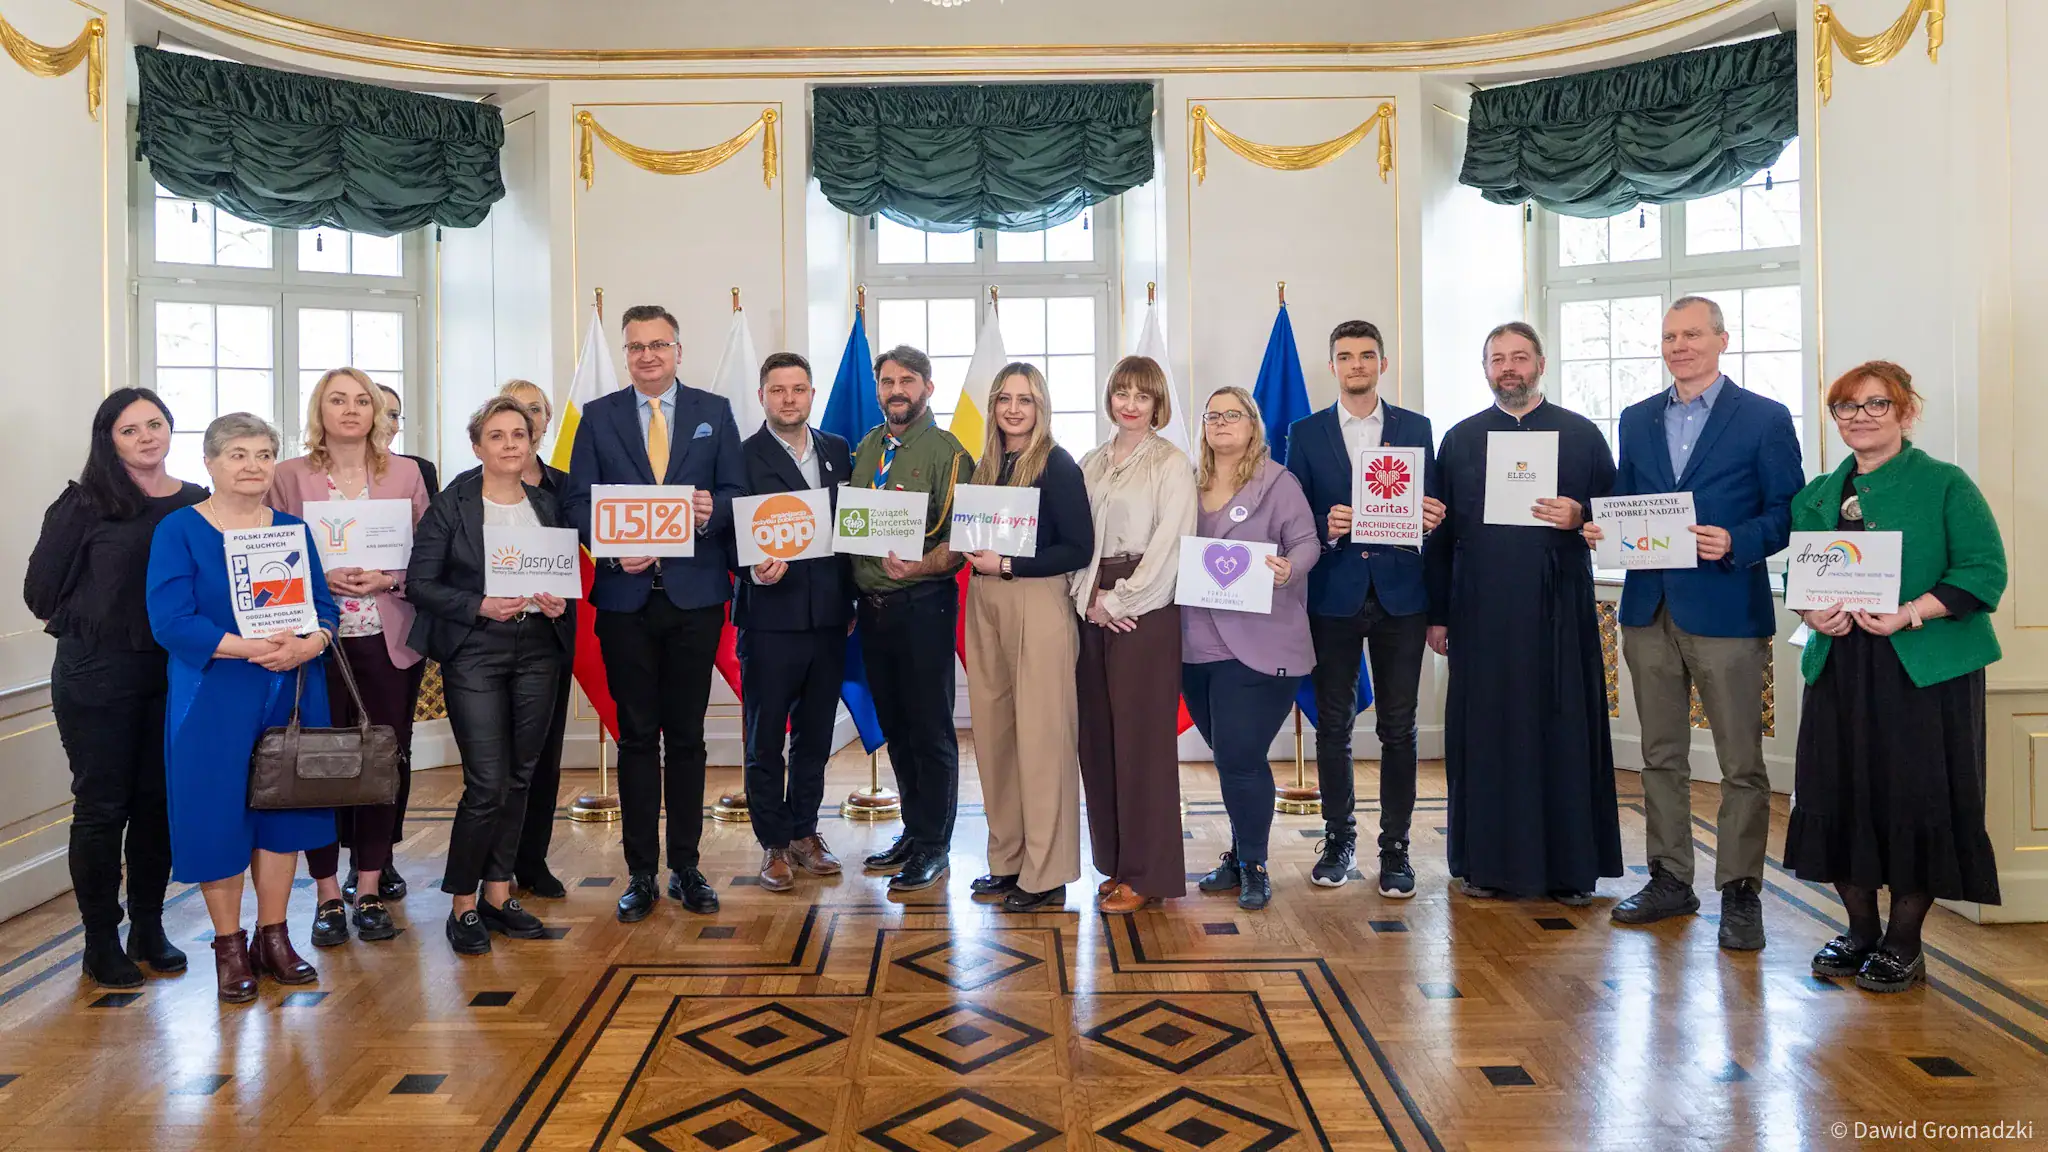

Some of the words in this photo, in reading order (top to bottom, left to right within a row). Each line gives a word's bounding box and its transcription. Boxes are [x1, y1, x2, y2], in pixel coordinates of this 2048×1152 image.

[1366, 502, 1409, 514] caritas
[1603, 498, 1680, 509] STOWARZYSZENIE
[870, 508, 909, 519] Związek
[1615, 509, 1648, 518] DOBREJ
[602, 504, 683, 540] 1,5%
[870, 518, 923, 527] Harcerstwa
[1356, 521, 1418, 530] ARCHIDIECEZJI
[233, 533, 261, 541] POLSKI
[753, 521, 815, 550] opp
[870, 528, 916, 538] Polskiego
[1355, 530, 1419, 539] BIAŁOSTOCKIEJ
[245, 541, 287, 550] GŁUCHYCH
[519, 553, 555, 571] Jasny
[556, 554, 574, 569] Cel
[1796, 543, 1843, 577] droga
[233, 555, 253, 610] PZG
[1817, 595, 1836, 603] KRS
[245, 612, 272, 620] ODDZIAŁ
